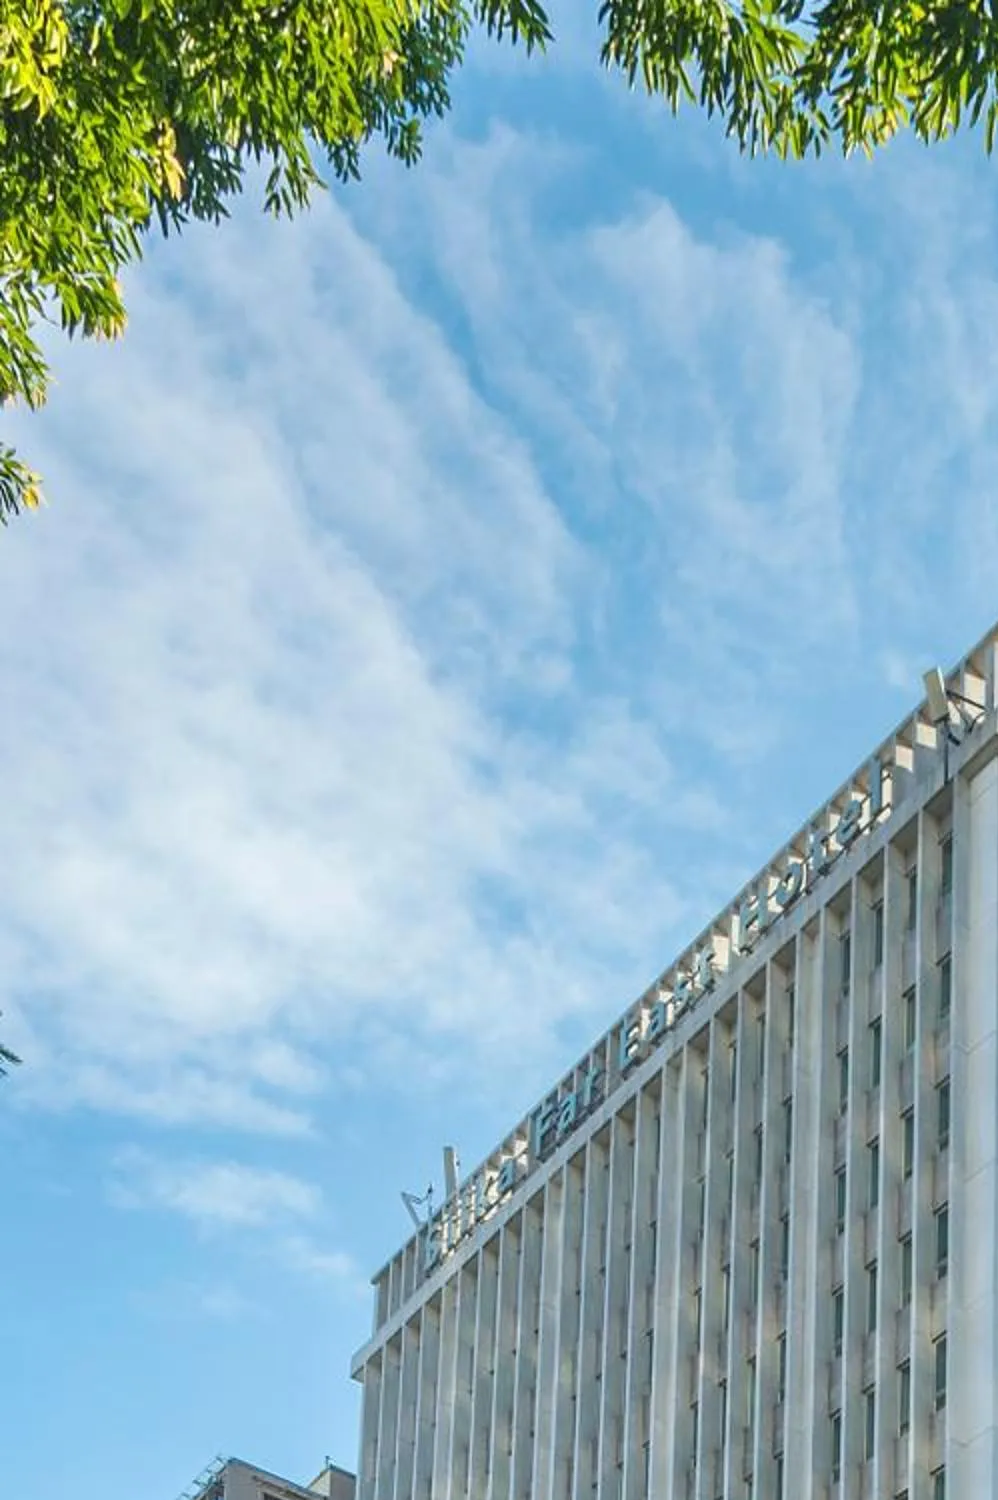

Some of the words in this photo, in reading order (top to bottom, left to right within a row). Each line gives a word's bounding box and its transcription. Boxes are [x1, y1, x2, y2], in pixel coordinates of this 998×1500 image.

[533, 1067, 600, 1160] Far
[619, 941, 716, 1070] East
[737, 757, 888, 948] Hotel
